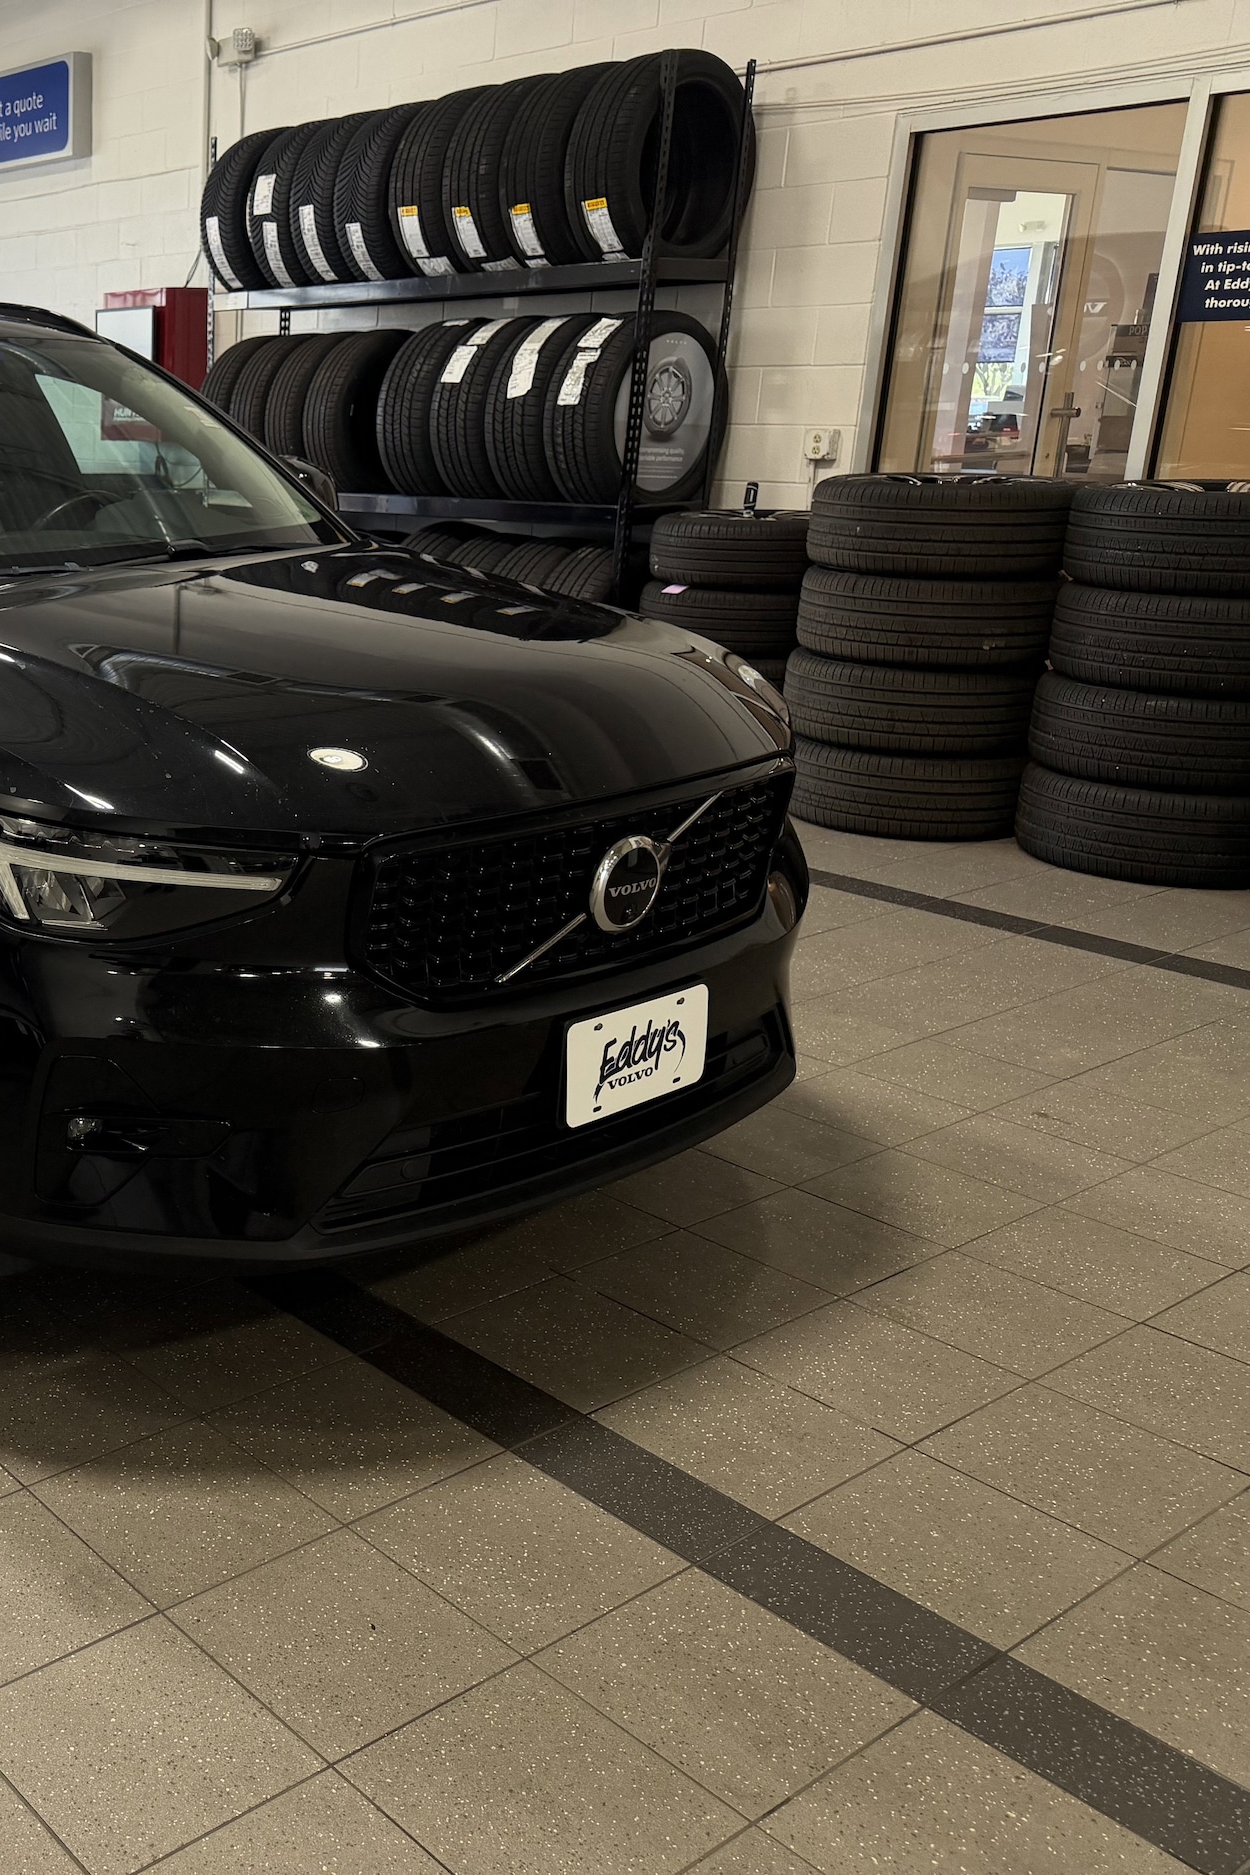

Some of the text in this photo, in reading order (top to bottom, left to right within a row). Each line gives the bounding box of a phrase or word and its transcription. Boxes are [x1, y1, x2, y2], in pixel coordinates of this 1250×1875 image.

[5, 102, 12, 116] a
[13, 92, 44, 117] quote
[13, 125, 32, 143] you
[34, 112, 57, 133] wait
[1193, 241, 1250, 256] With risi
[1200, 261, 1214, 273] in
[1204, 277, 1250, 292] At Edd
[1204, 296, 1250, 309] thorou
[608, 877, 657, 898] VOLVO
[598, 1018, 682, 1086] Eddy's
[607, 1066, 654, 1090] VOLVO
